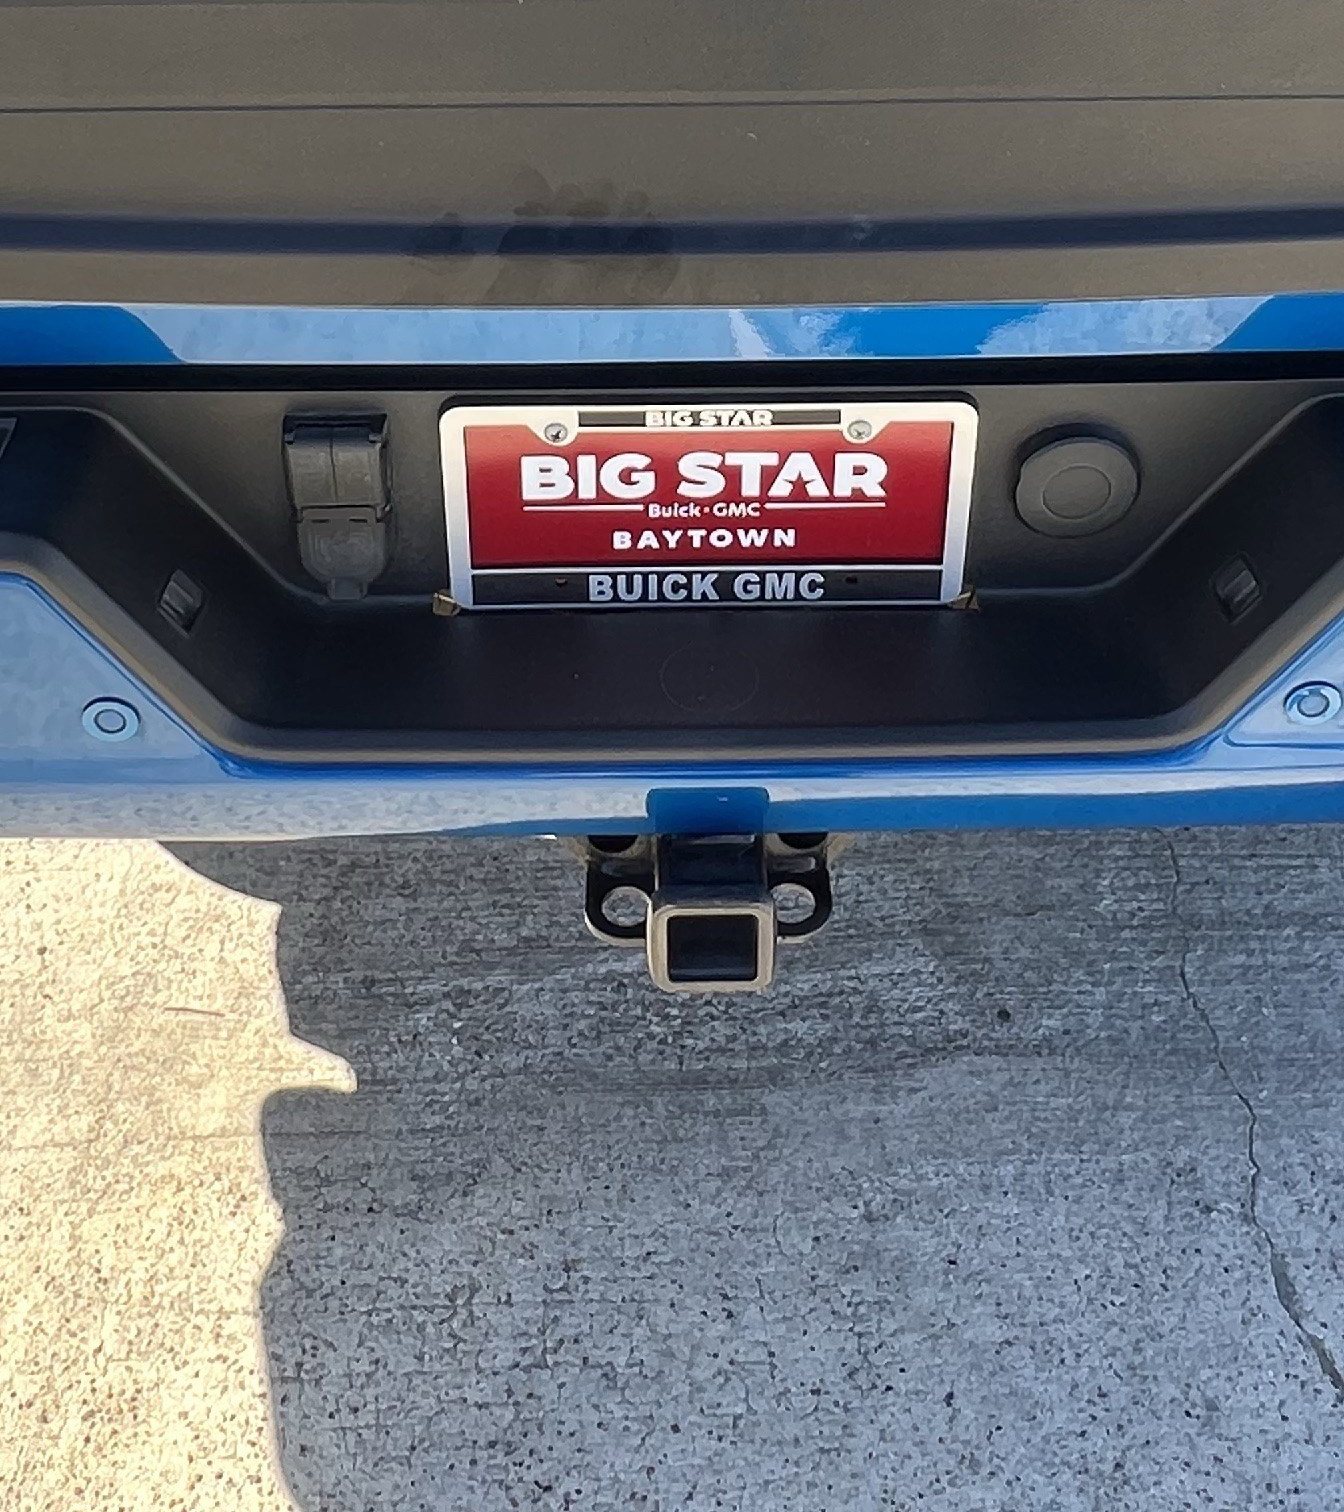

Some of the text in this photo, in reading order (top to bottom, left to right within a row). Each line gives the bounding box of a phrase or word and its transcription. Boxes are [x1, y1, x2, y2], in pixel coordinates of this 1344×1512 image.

[644, 408, 775, 427] BIG STAR
[520, 451, 889, 501] BIG STAR
[611, 528, 797, 550] BAYTOWN
[587, 572, 825, 602] BUICK GMC
